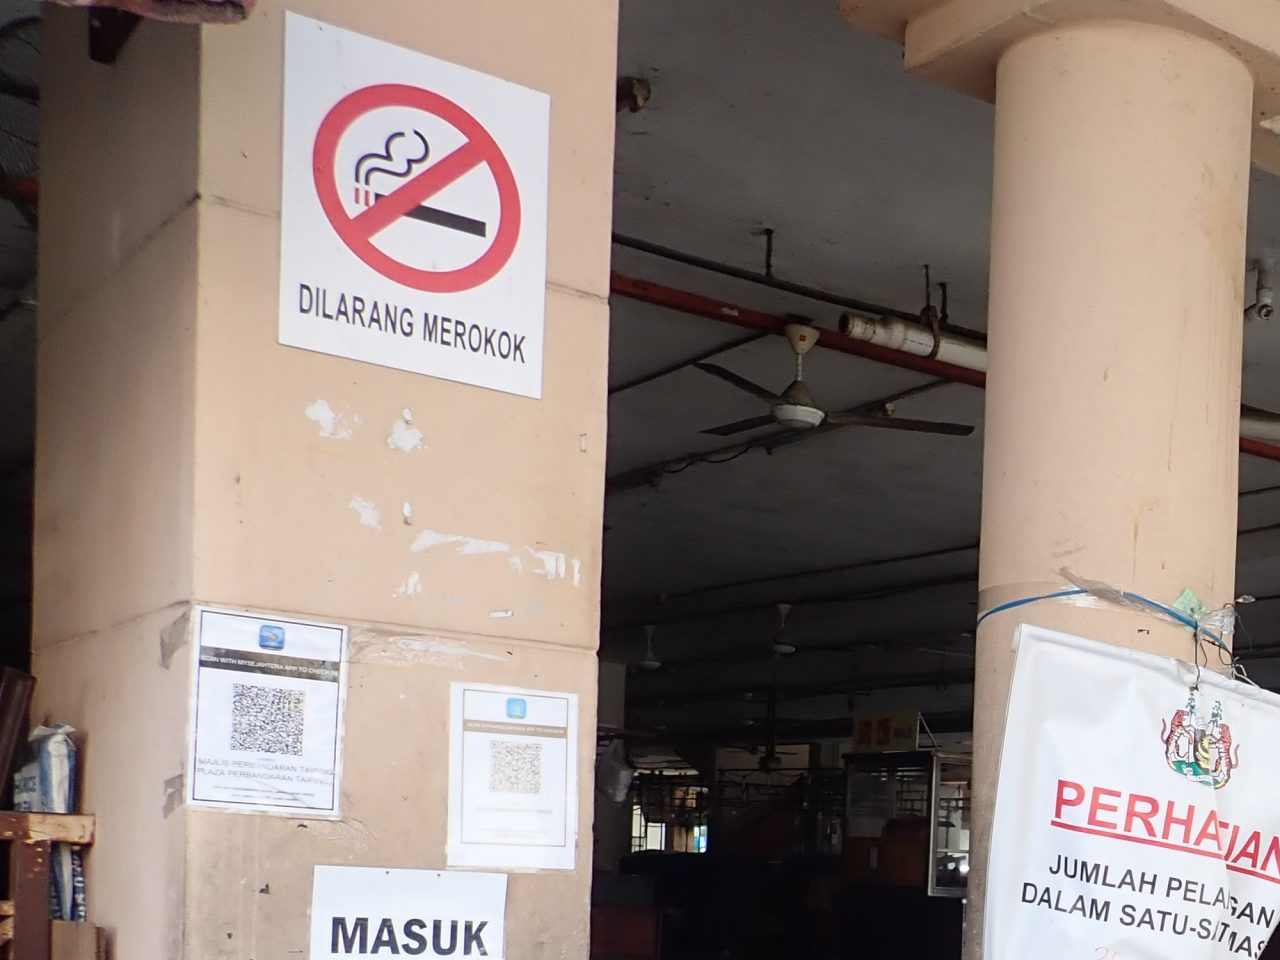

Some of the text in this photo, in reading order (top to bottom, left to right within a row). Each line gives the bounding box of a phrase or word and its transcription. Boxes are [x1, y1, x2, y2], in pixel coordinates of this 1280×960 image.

[299, 283, 526, 363] DILARANG MEROKOK
[197, 768, 225, 776] PLAZA
[199, 758, 230, 767] MAJLIS
[1049, 854, 1158, 895] JUMLAH
[1021, 882, 1110, 922] DALAM
[331, 916, 489, 957] MASUK
